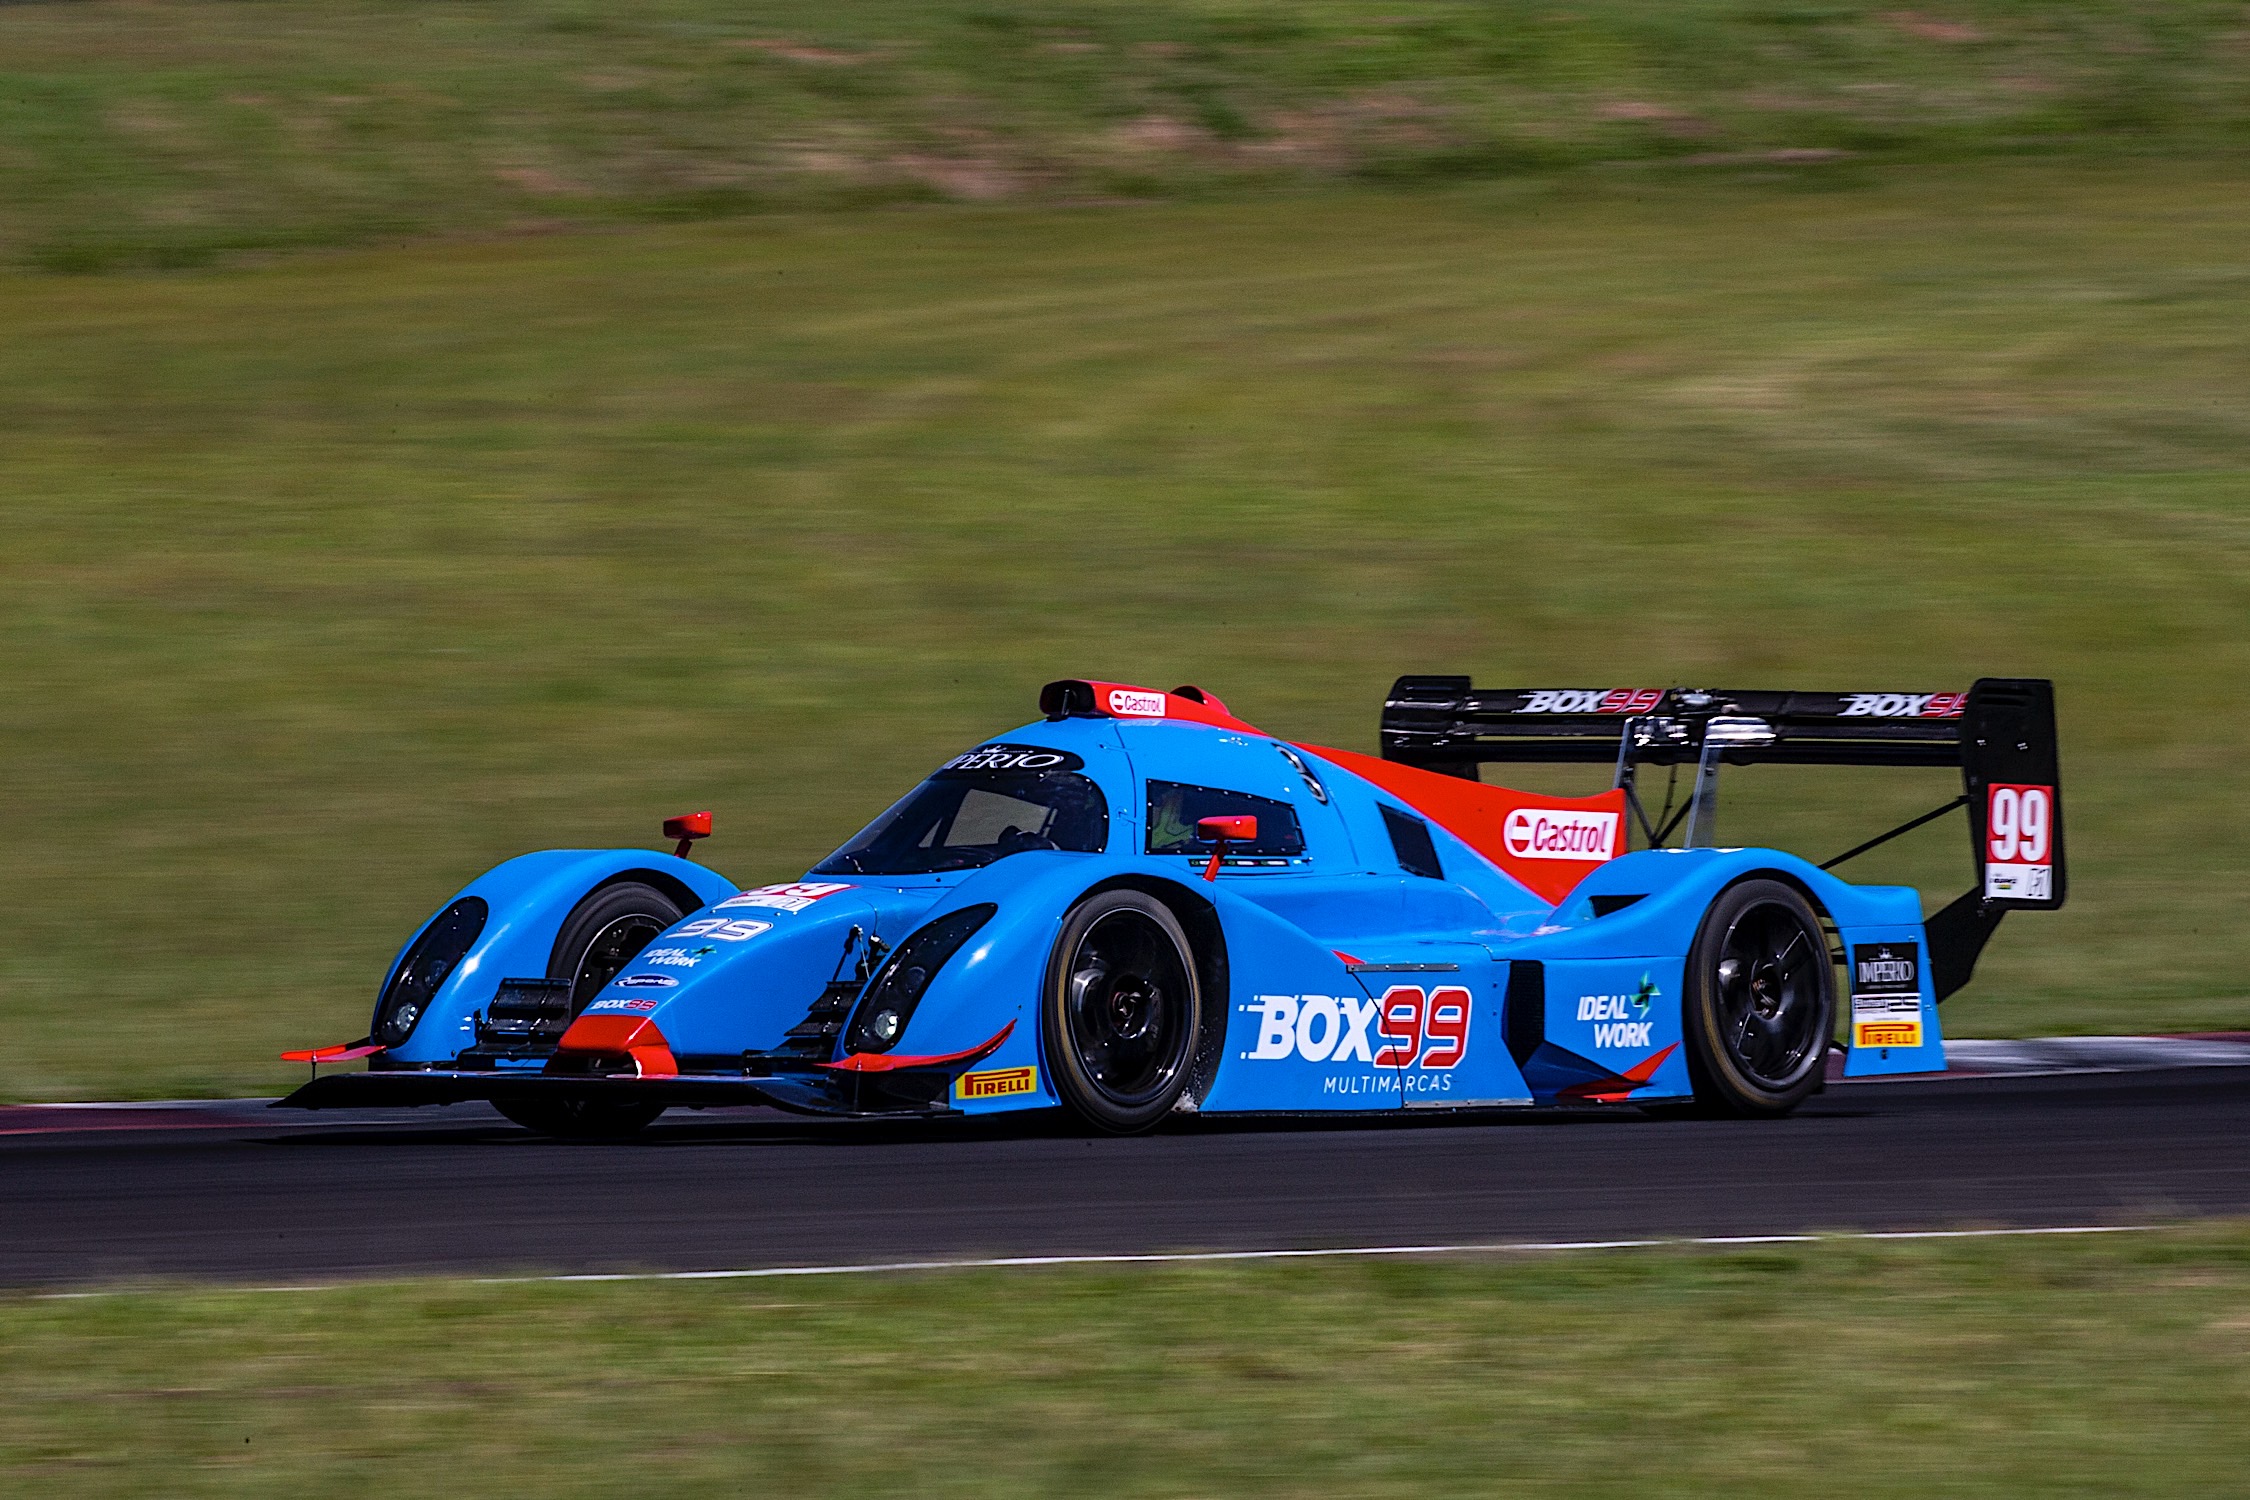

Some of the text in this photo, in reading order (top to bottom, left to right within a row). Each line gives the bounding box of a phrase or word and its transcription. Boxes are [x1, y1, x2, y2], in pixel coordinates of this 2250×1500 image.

[1125, 695, 1161, 712] Castrol
[1512, 688, 1665, 713] BOX99
[1534, 817, 1609, 852] Castrol
[1991, 787, 2050, 862] 99
[663, 917, 774, 942] 99
[643, 948, 688, 957] IDEAL
[648, 956, 702, 968] WORK
[590, 998, 658, 1011] BOX99
[1576, 995, 1630, 1021] IDEAL
[1238, 985, 1473, 1069] BOX99
[1593, 1021, 1654, 1049] WORK
[1862, 1024, 1916, 1045] PIRELLI
[964, 1068, 1031, 1096] PIRELLI
[1322, 1073, 1453, 1094] MULTIMARCAS
